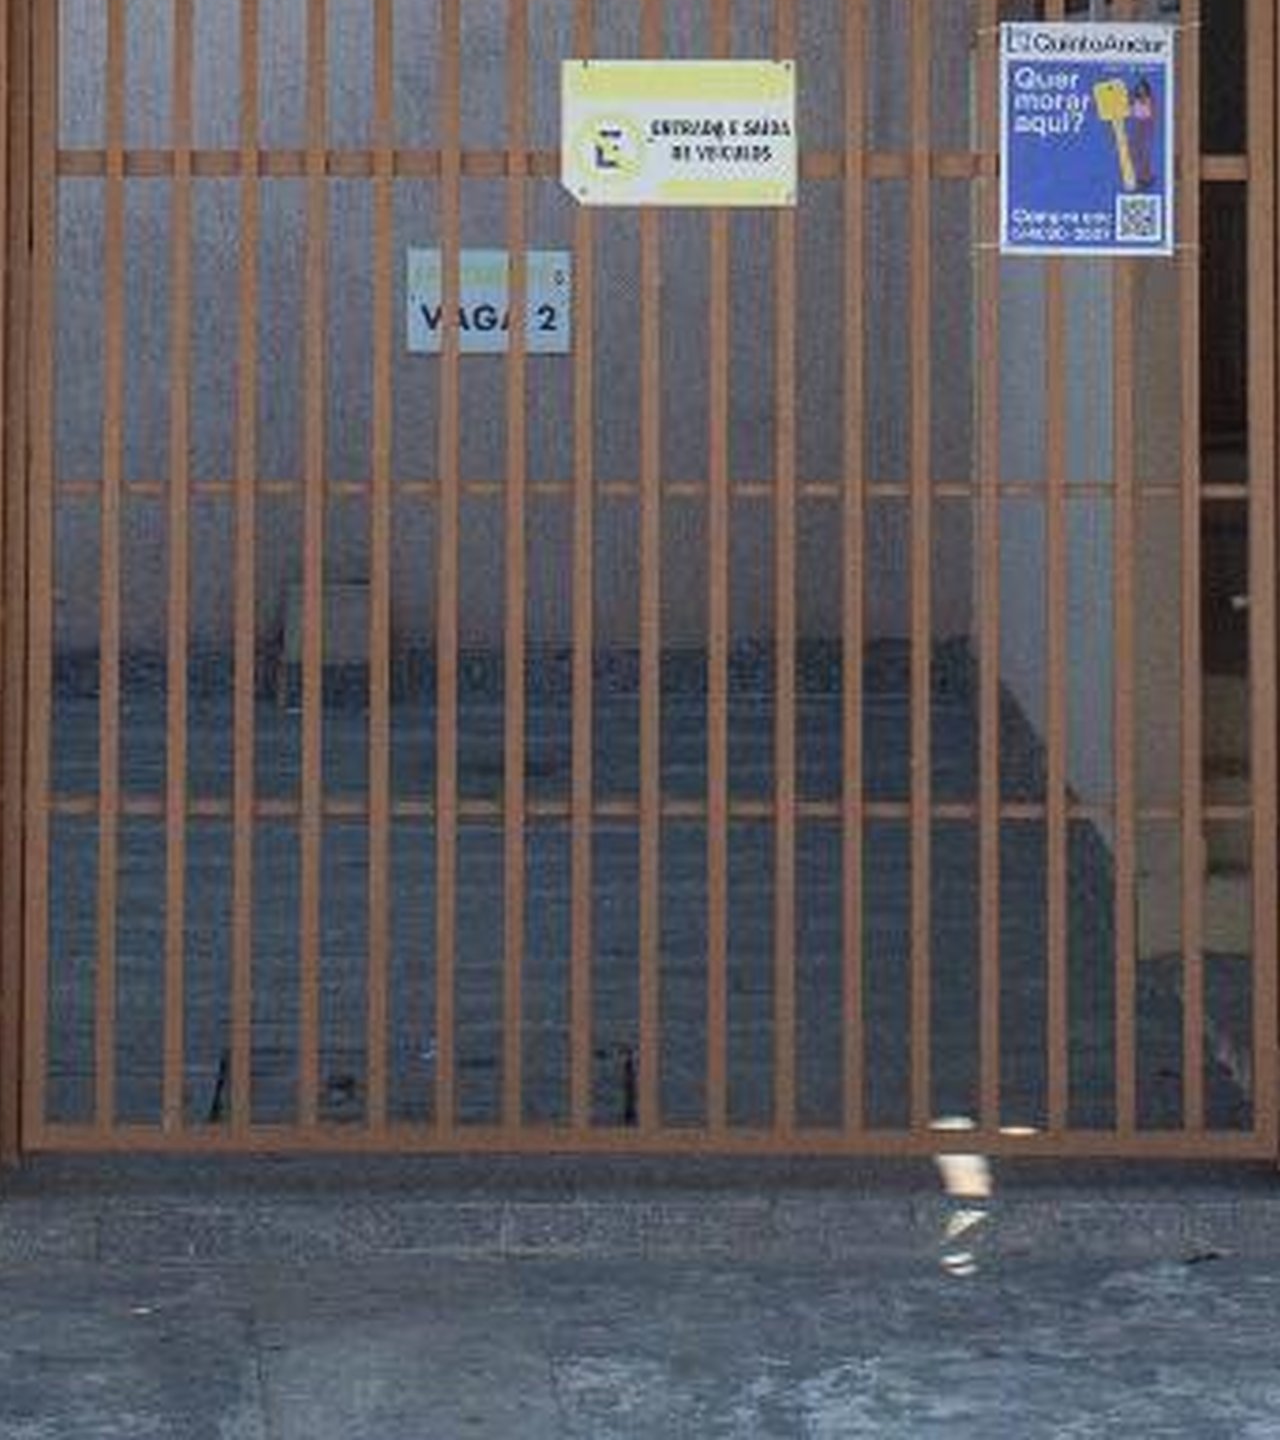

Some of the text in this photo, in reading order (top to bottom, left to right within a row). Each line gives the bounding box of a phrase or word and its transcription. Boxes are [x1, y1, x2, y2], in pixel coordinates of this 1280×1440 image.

[1014, 66, 1080, 91] Quer
[1014, 93, 1090, 111] morar
[1014, 111, 1085, 138] aqui?
[536, 304, 558, 331] 2
